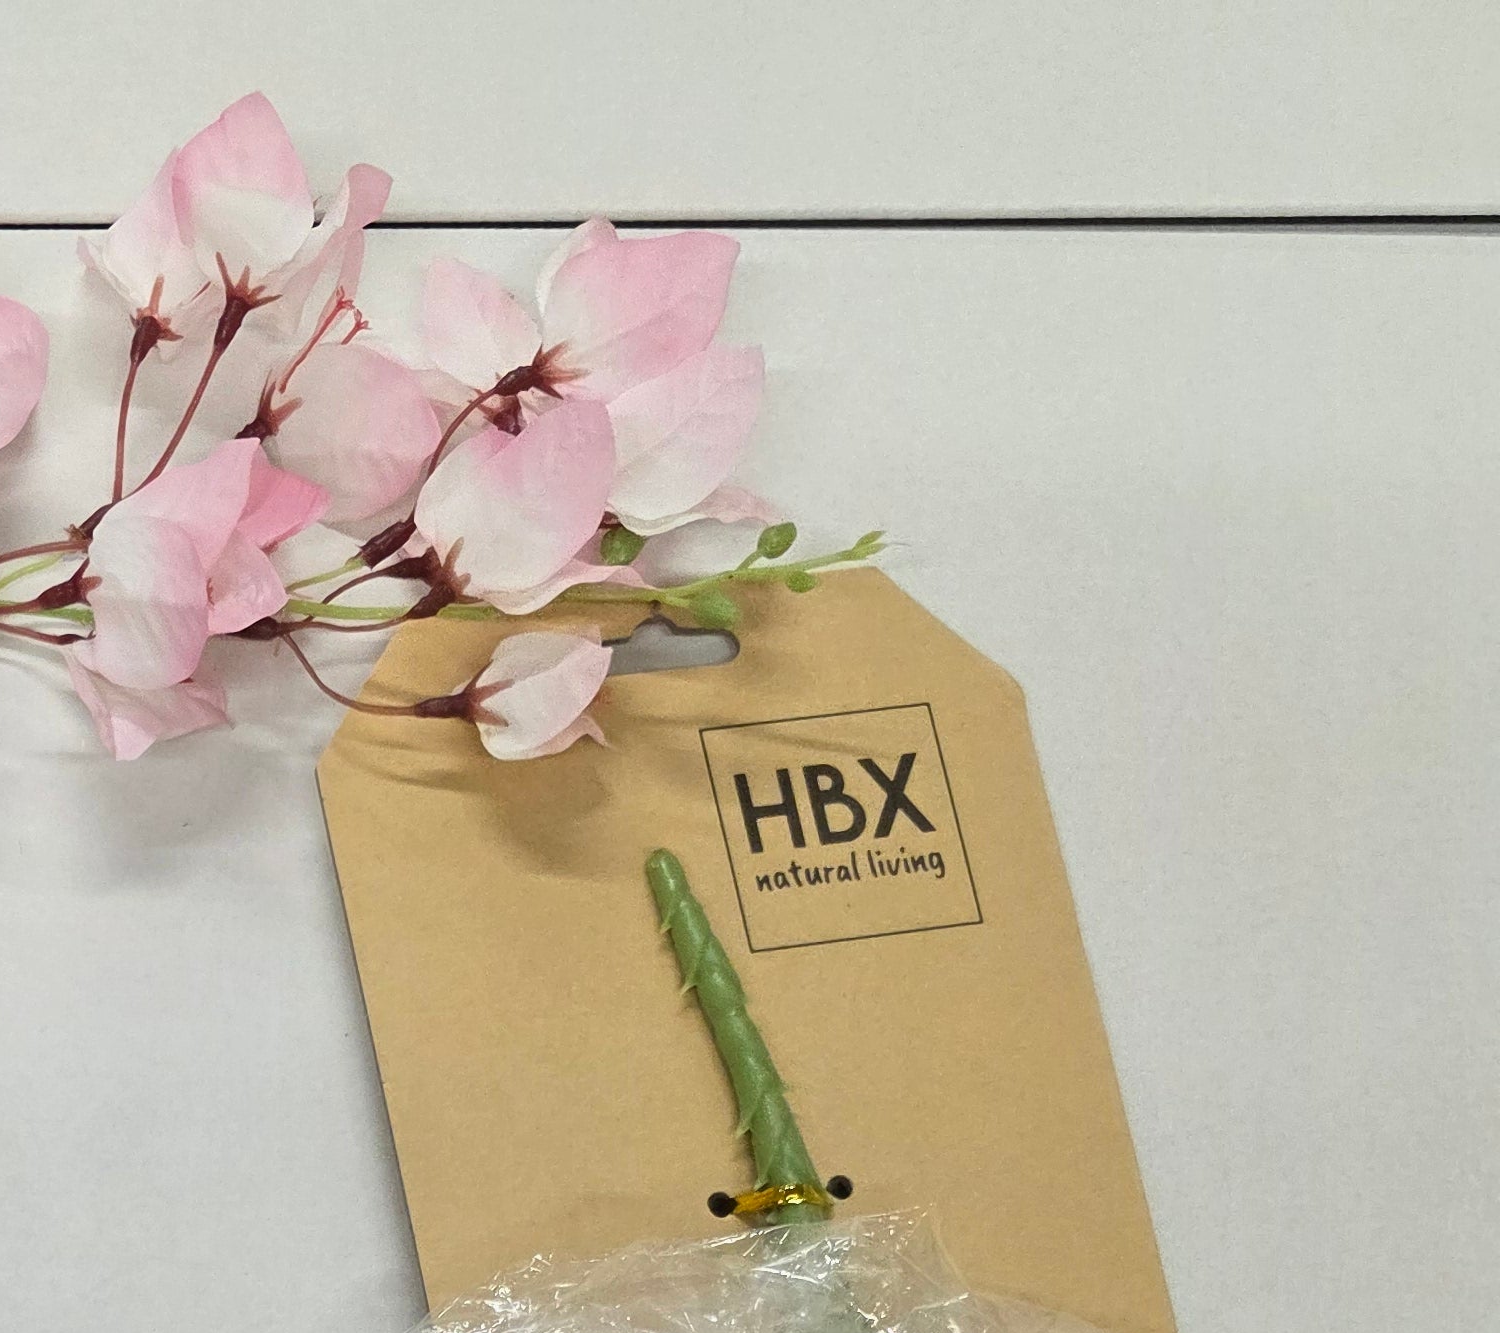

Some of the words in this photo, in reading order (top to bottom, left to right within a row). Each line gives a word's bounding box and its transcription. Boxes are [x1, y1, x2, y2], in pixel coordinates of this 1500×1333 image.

[733, 752, 937, 854] HBX
[755, 851, 861, 892] natural
[867, 846, 946, 879] living
